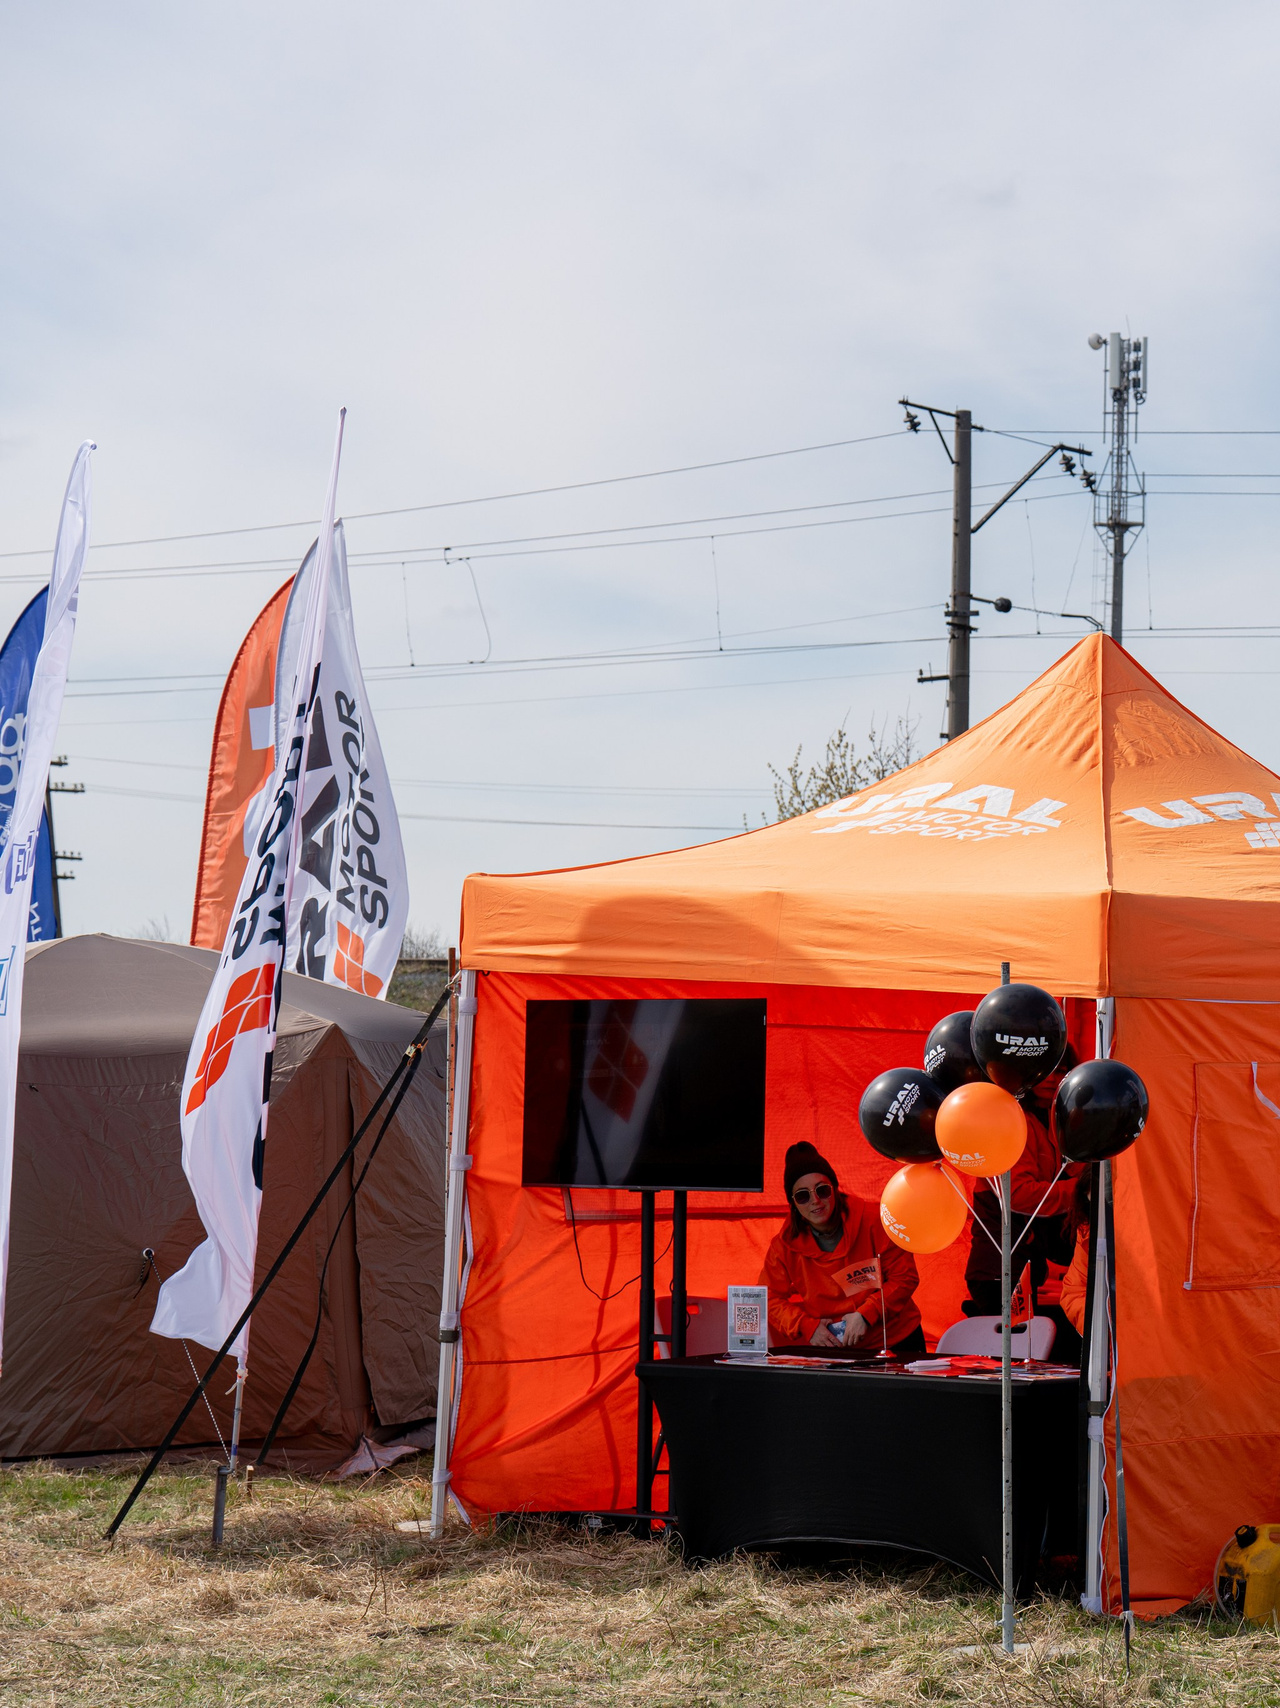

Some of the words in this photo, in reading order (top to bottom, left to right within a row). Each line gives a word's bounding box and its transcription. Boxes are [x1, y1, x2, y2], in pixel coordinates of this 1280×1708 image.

[815, 782, 1068, 828] URAL
[868, 823, 1012, 842] SPORT
[898, 810, 1048, 836] MOTOR
[296, 696, 341, 981] RAL
[995, 1032, 1049, 1047] URAL
[924, 1044, 946, 1071] RAL
[883, 1083, 916, 1127] URAL
[902, 1085, 920, 1110] MOTOR
[905, 1090, 921, 1114] SPORT
[940, 1146, 985, 1161] URAL
